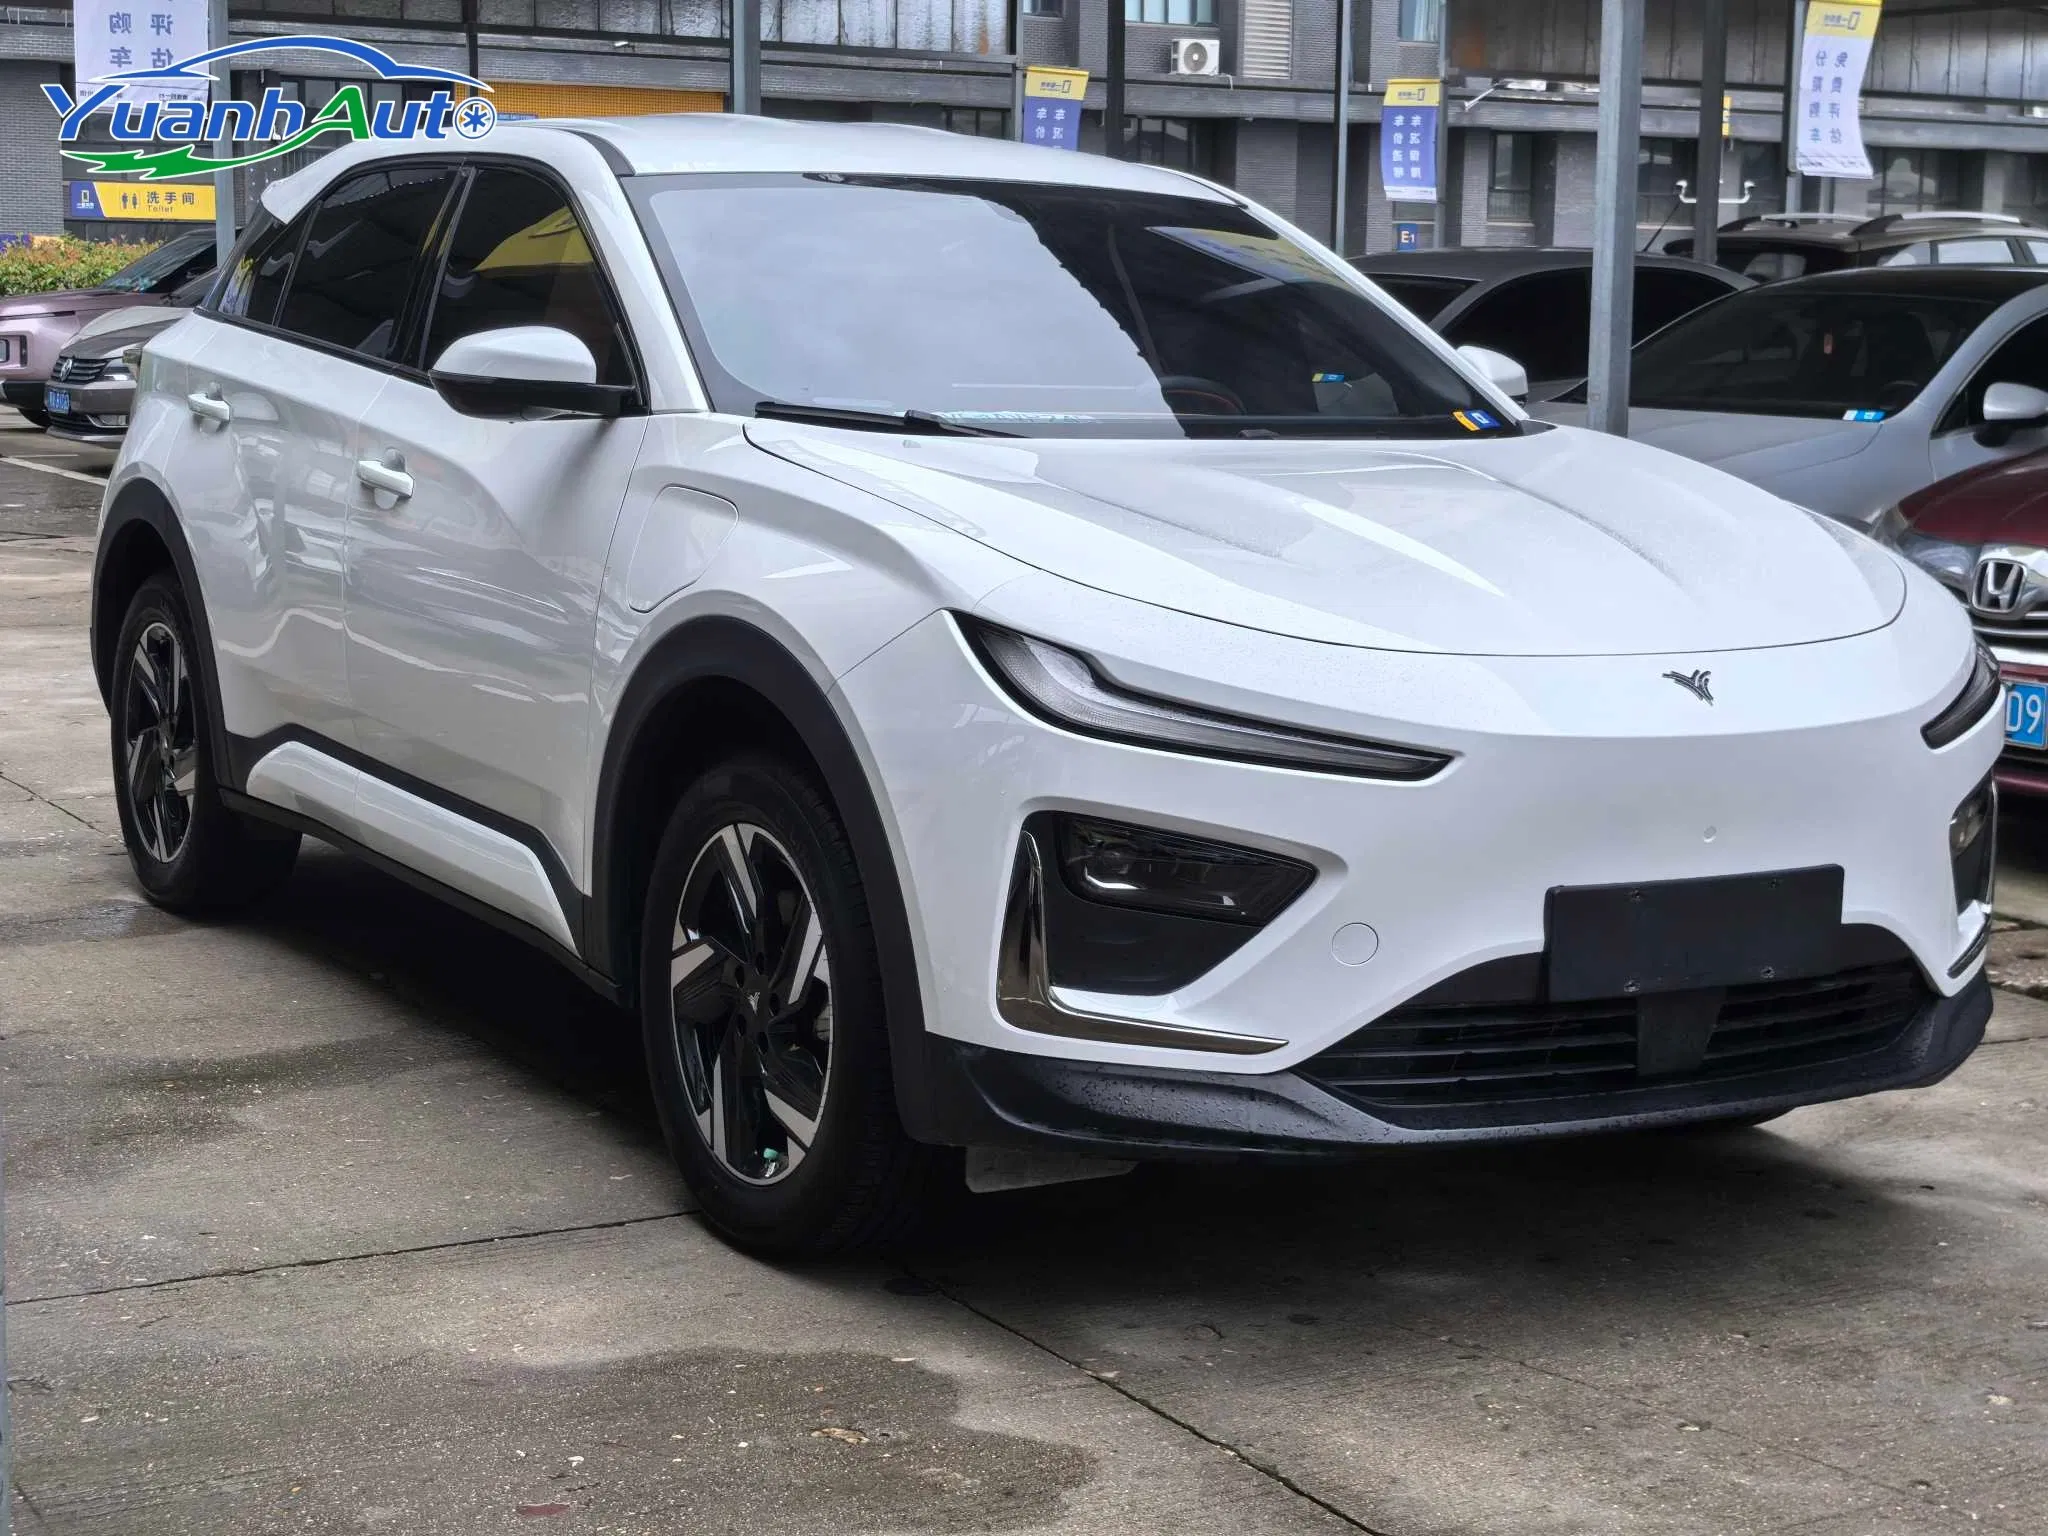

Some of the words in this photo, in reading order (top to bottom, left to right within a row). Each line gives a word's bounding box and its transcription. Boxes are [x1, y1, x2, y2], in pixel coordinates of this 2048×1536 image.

[146, 191, 195, 205] 洗手间
[1401, 230, 1415, 243] E1
